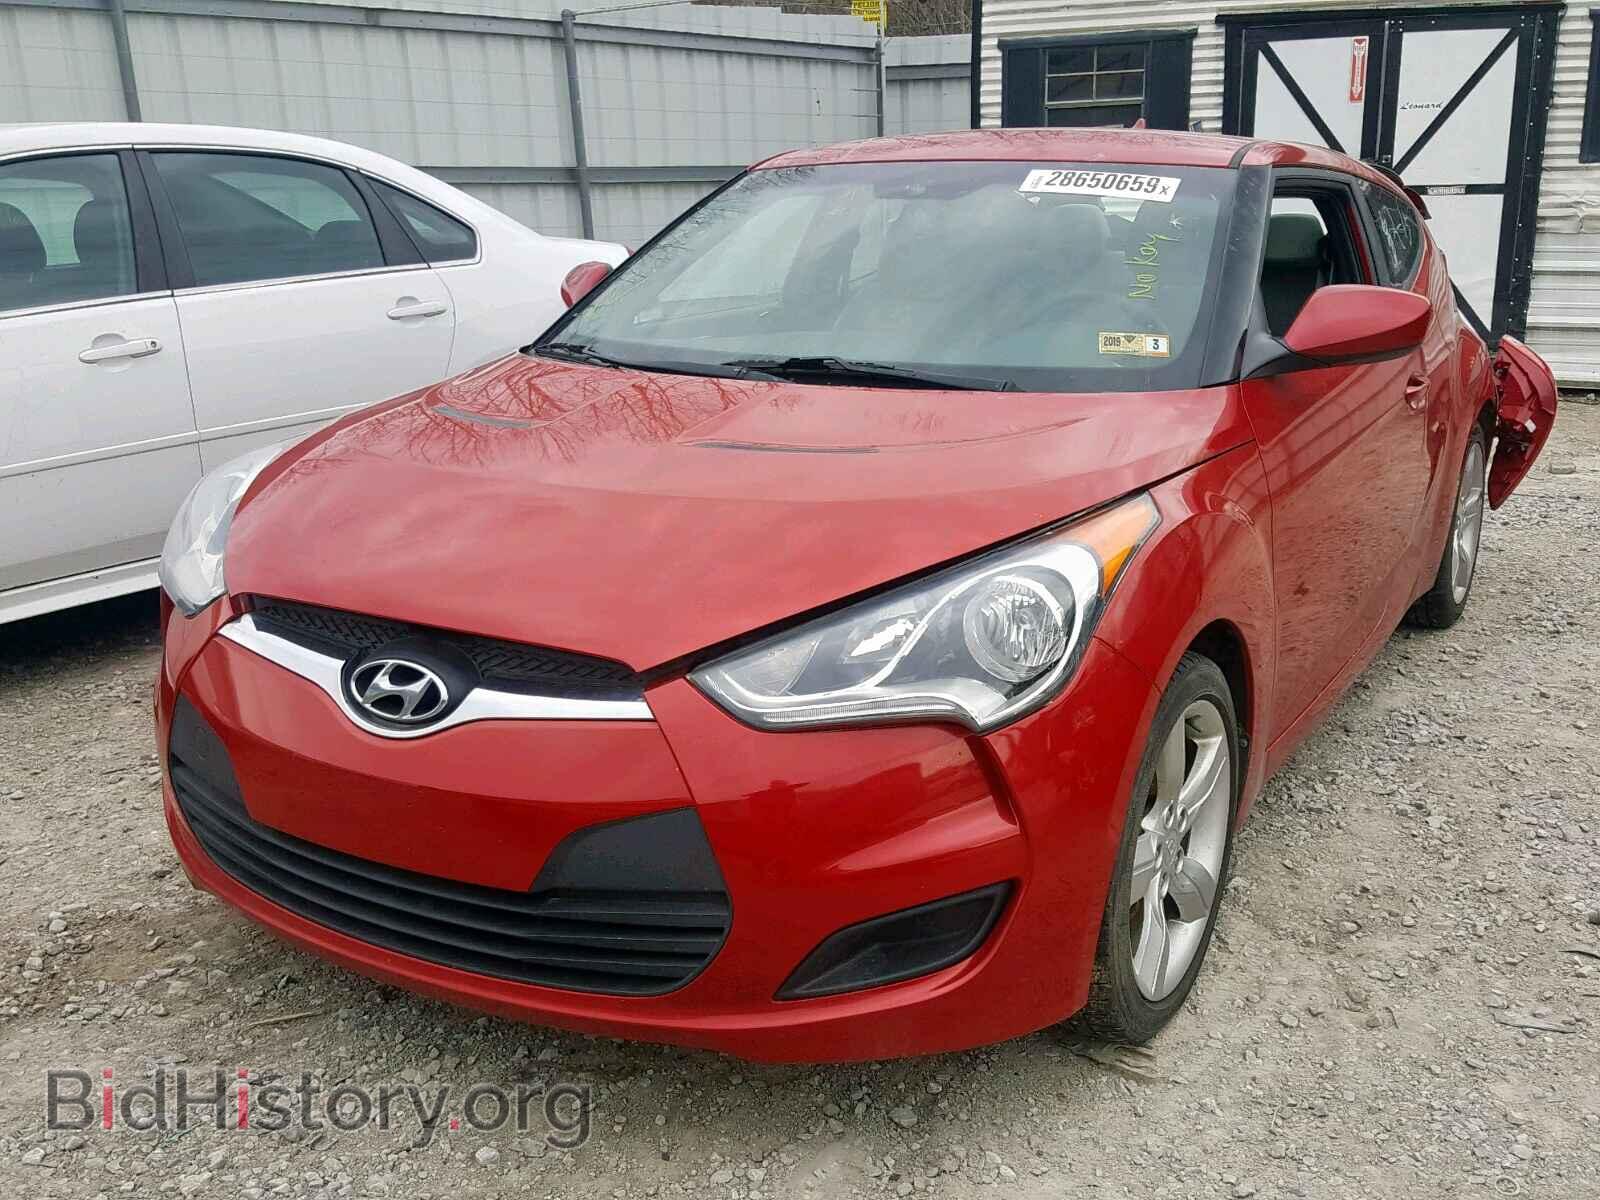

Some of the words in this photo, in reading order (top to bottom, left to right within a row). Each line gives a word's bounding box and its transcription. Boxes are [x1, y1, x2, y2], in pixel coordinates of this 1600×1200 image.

[1045, 171, 1161, 194] 28650659
[1103, 336, 1121, 347] 2019
[1152, 338, 1160, 350] 3
